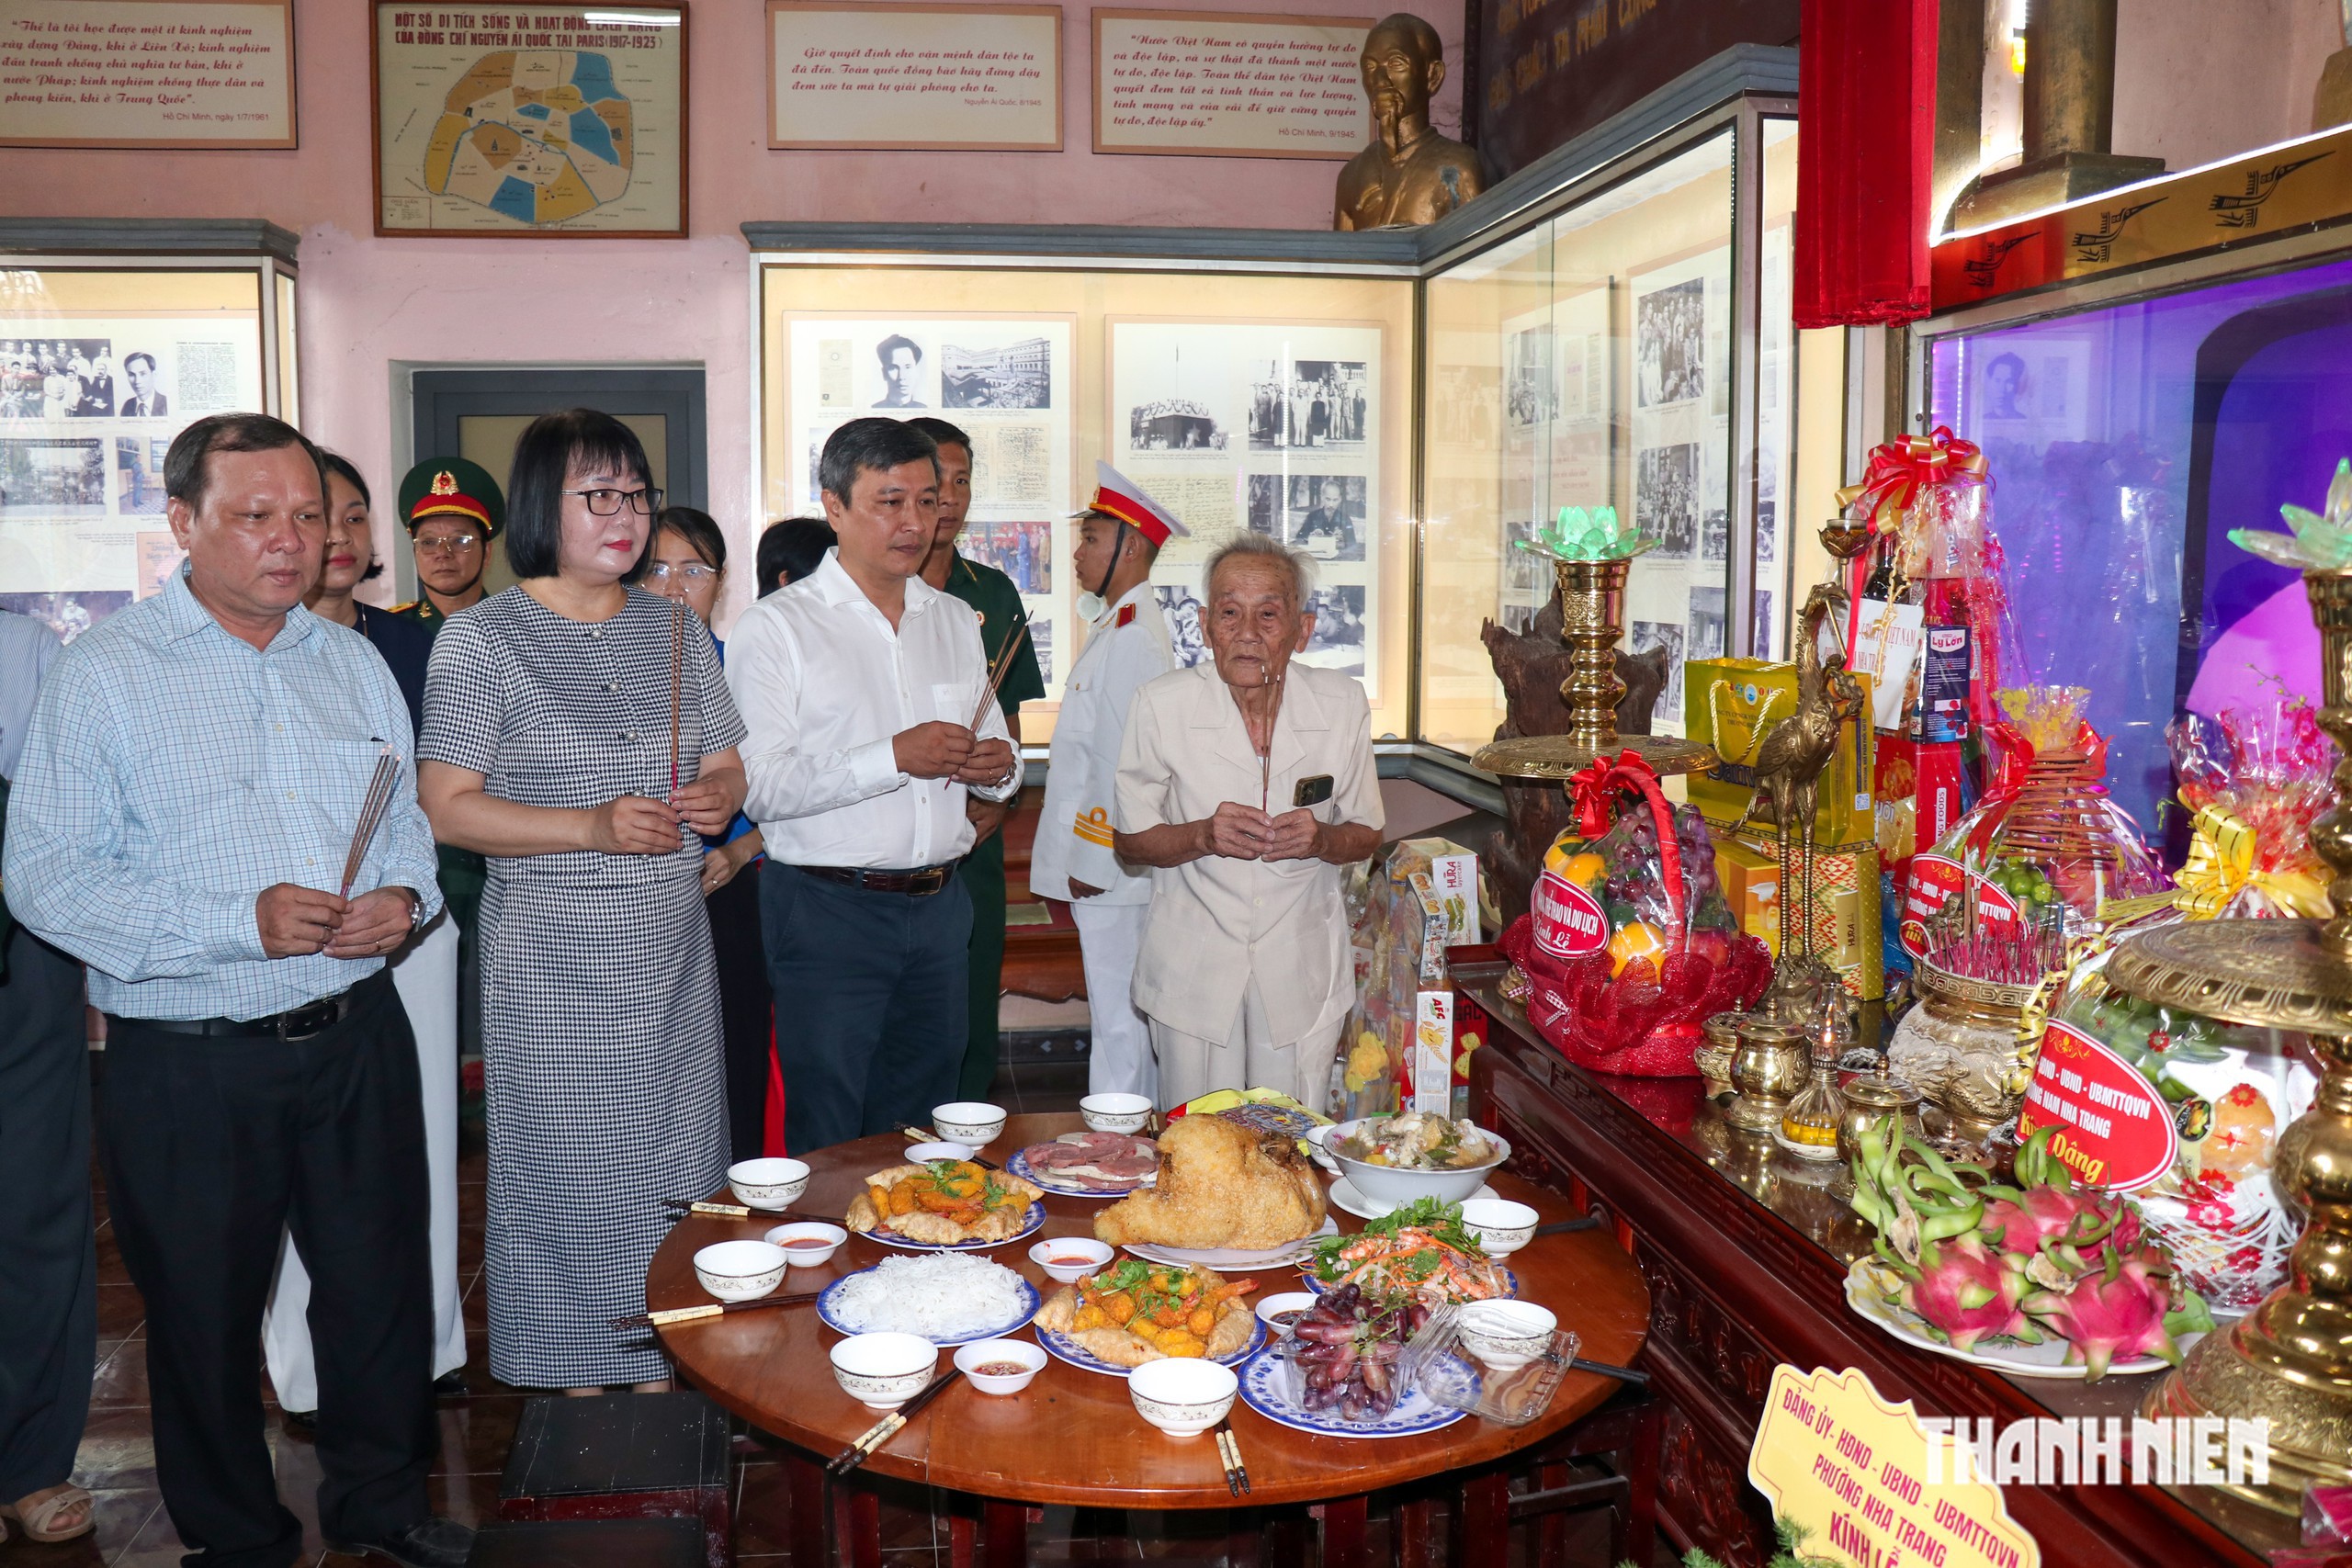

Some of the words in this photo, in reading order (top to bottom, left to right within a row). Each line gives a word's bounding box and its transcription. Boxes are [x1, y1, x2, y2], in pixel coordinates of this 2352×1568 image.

[1932, 637, 1944, 648] Ly
[1938, 791, 1946, 824] FOODS
[1446, 861, 1457, 888] HURA
[1580, 912, 1599, 938] LỊCH
[1431, 998, 1446, 1020] AFC
[2042, 1089, 2060, 1116] NAM
[2060, 1100, 2079, 1125] NHA
[2078, 1109, 2112, 1139] TRANG
[2059, 1068, 2083, 1094] UBND
[2088, 1082, 2152, 1120] UBMTTQVN
[2052, 1133, 2104, 1183] Dâng
[1782, 1387, 1815, 1427] ĐẢNG
[1836, 1428, 1872, 1470] HĐND
[1880, 1462, 1922, 1506] UBND
[1933, 1498, 2019, 1568] UBMTTQVN
[1812, 1453, 1863, 1508] PHƯỜNG
[1861, 1493, 1894, 1534] NHA
[1895, 1516, 1948, 1568] TRANG
[1829, 1511, 1871, 1565] KÍNH
